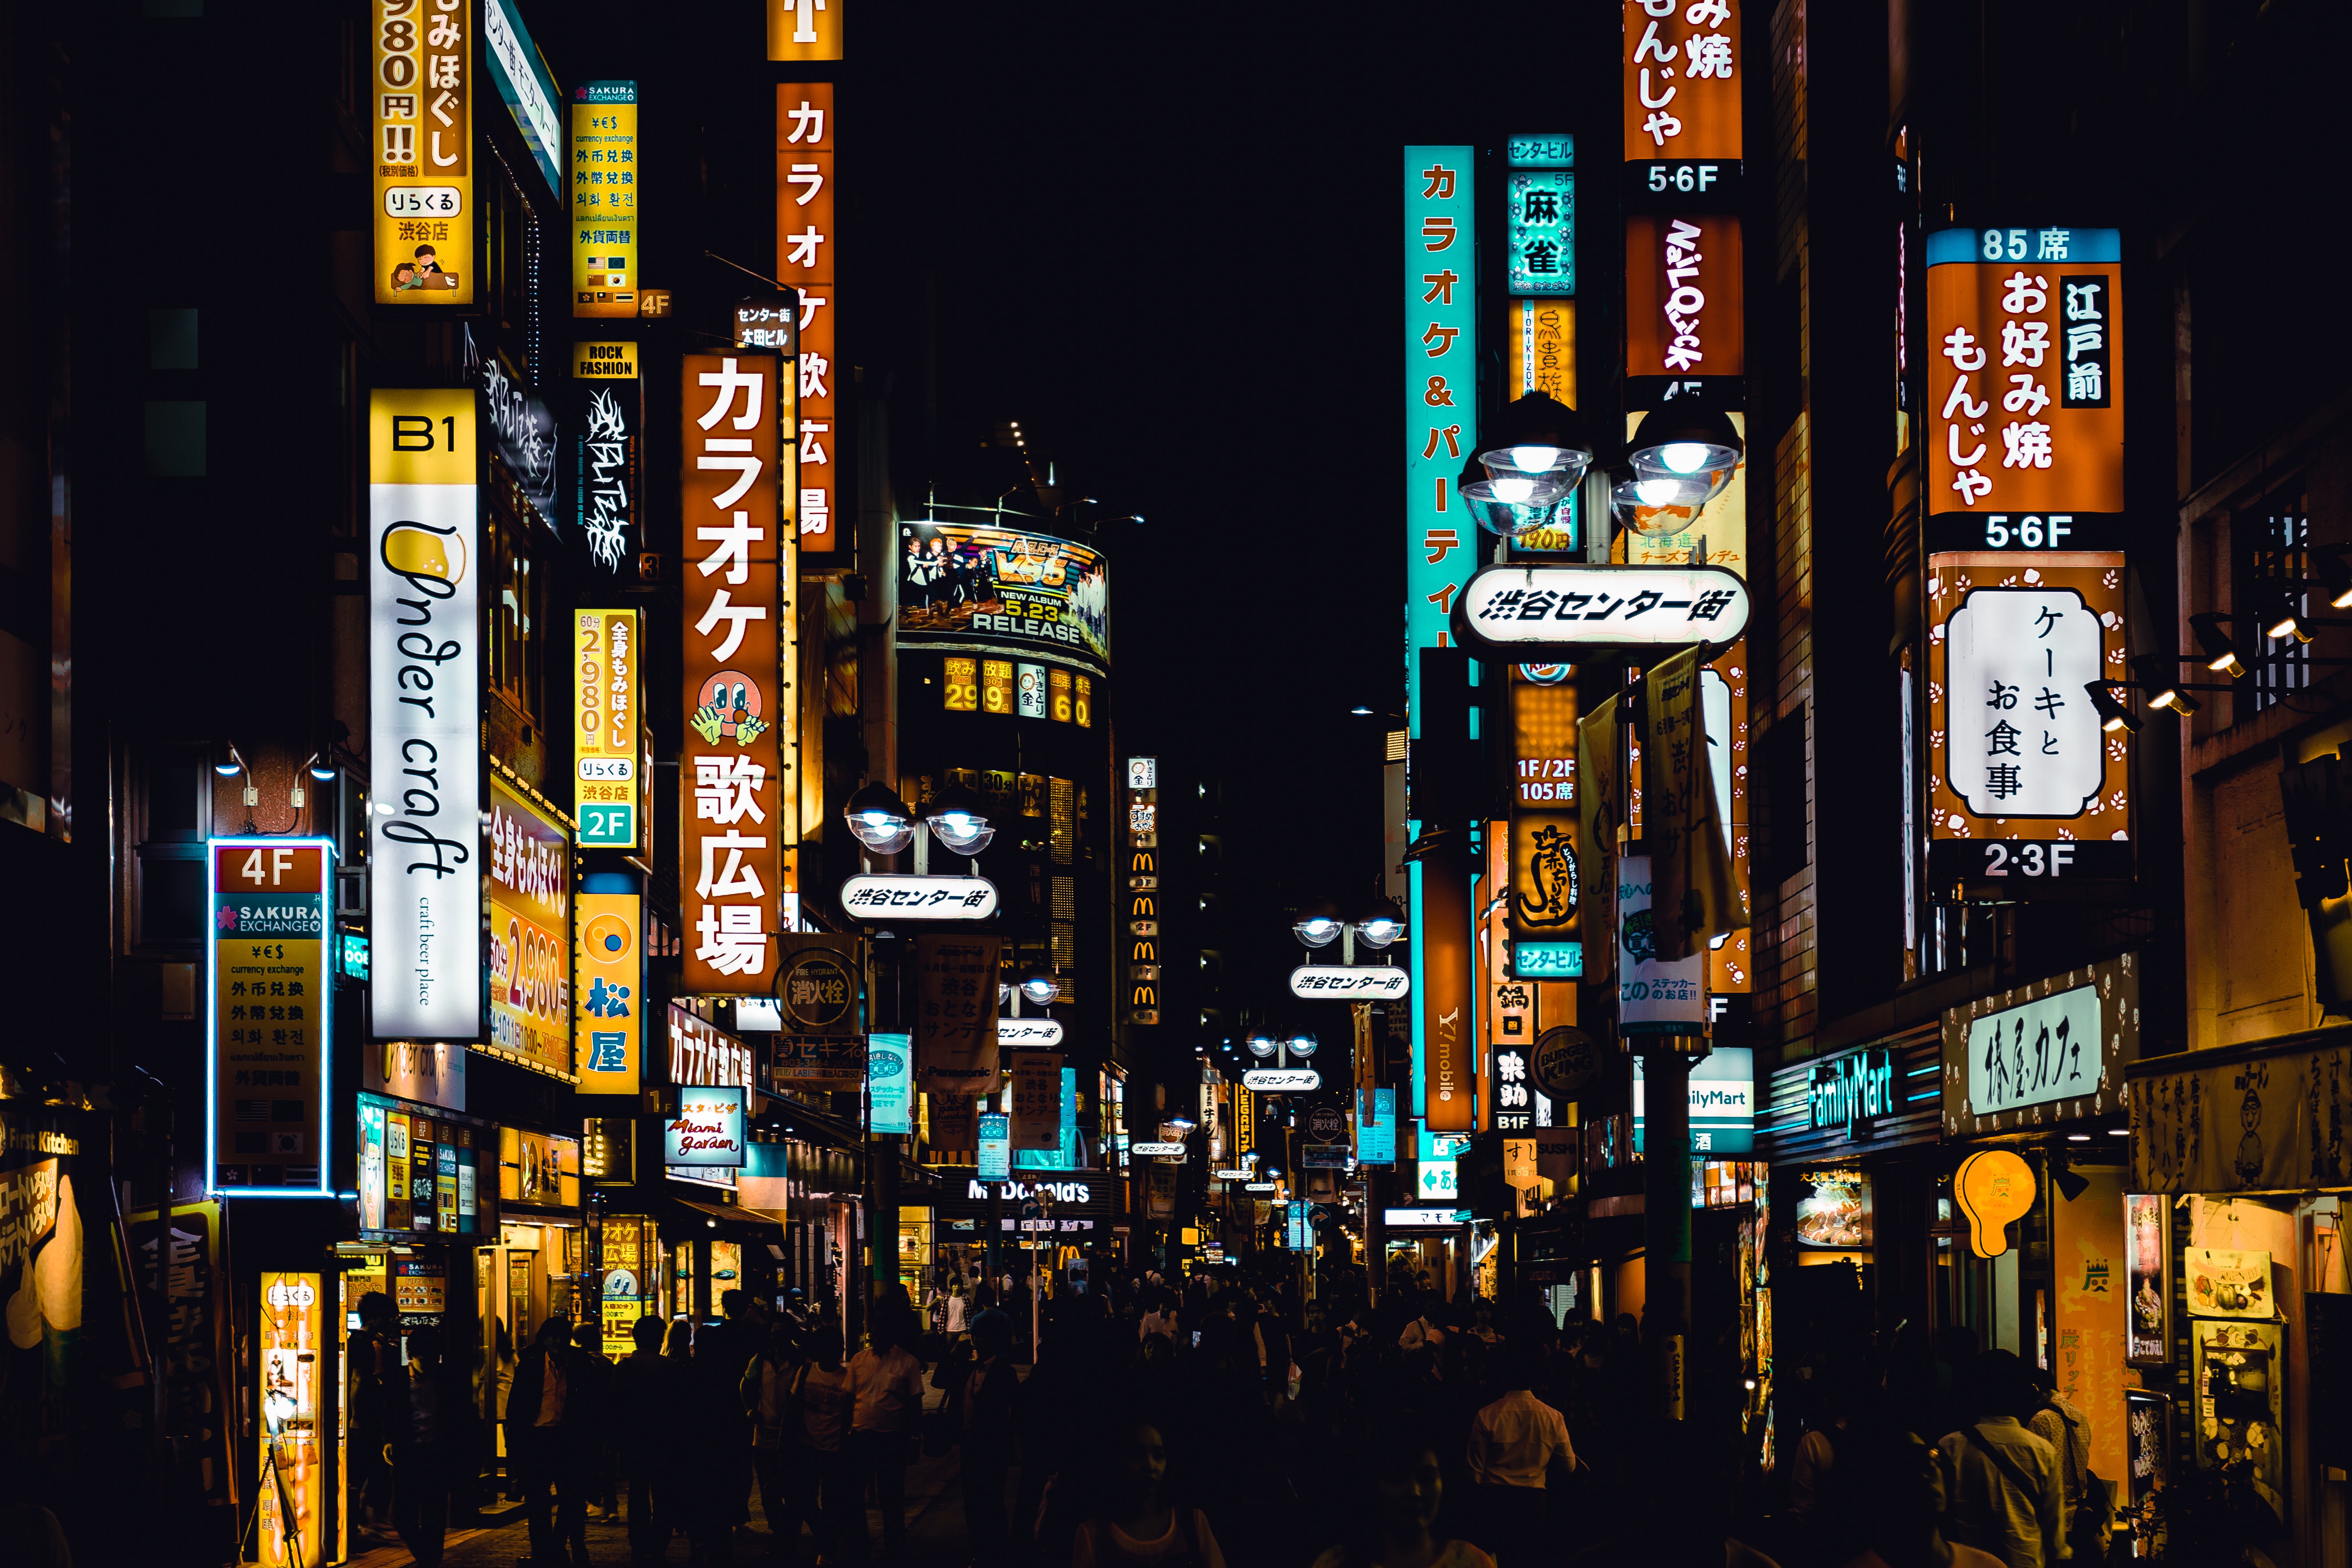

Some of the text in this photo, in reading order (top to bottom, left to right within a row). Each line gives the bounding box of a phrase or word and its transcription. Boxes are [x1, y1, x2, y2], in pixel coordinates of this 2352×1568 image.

[1685, 0, 1733, 78] み焼
[576, 134, 634, 144] currency exchange
[576, 149, 634, 163] 外币兑换
[1510, 142, 1573, 159] センタービル
[1555, 174, 1573, 187] 5F
[392, 194, 453, 210] りらくる
[576, 192, 634, 207] 외화 환전
[398, 222, 448, 241] 渋谷店
[579, 230, 631, 244] 外貨両替
[1524, 190, 1559, 274] 麻雀
[641, 295, 668, 314] 4F
[738, 308, 791, 323] センター街
[2066, 284, 2102, 401] 江戸前
[589, 346, 624, 359] ROCK
[580, 362, 632, 375] FASHION
[2002, 271, 2053, 469] お好み焼
[1942, 327, 1993, 506] もんじゃ
[393, 416, 454, 452] B1
[1640, 533, 1693, 548] 北海道
[1640, 550, 1741, 564] チーズフンデュ
[1001, 591, 1062, 607] NEW ALBUM
[1478, 589, 1737, 621] 渋谷センター街
[1005, 600, 1058, 622] 5.23
[973, 613, 1080, 644] RELEASE
[695, 358, 767, 976] カラオケ 歌広場
[580, 615, 602, 746] 60分 2,980円
[611, 622, 628, 747] 全身もみほぐし
[2034, 605, 2066, 756] ケーキと
[1022, 691, 1034, 707] 金
[1035, 669, 1044, 715] やきとり
[1985, 680, 2023, 800] お食事
[584, 763, 628, 776] りらくる
[984, 772, 1013, 791] 30分
[1134, 775, 1144, 785] 金
[583, 785, 629, 800] 渋谷店
[1520, 782, 1574, 801] 105席
[381, 738, 469, 880] craft
[588, 812, 625, 837] 2F
[242, 849, 294, 885] 4F
[491, 805, 566, 918] 全身もみほぐし
[849, 889, 989, 907] 渋谷センター街
[240, 907, 321, 932] SAKURA EXCHANGE
[415, 897, 435, 1005] craft beer place
[1516, 949, 1581, 969] センタービル
[231, 965, 304, 976] currency exchange
[509, 917, 569, 1026] 2,980円
[231, 981, 304, 996] 外币兑换
[791, 979, 845, 1004] 消火栓
[941, 978, 978, 997] 渋谷
[1297, 976, 1405, 990] 渋谷センター街
[1621, 981, 1649, 1002] この
[1652, 979, 1696, 988] ステッカー
[1497, 985, 1530, 1010] 鍋
[1652, 989, 1697, 1000] のお店!!
[924, 1000, 993, 1017] おとなり
[584, 977, 631, 1072] 松屋
[924, 1022, 994, 1039] サンデー
[998, 1027, 1058, 1039] センター街
[231, 1029, 304, 1045] 외화 환전
[775, 1037, 863, 1059] 質 セキネ
[1439, 1006, 1458, 1102] Y! mobile
[1541, 1042, 1592, 1065] BURGER
[670, 1009, 752, 1111] カラオケ歌広場
[789, 1059, 854, 1068] 03-3464-2061
[1543, 1055, 1595, 1083] KING
[1984, 1015, 2082, 1107] 椿屋カフェ
[235, 1070, 300, 1086] 外貨両替
[775, 1068, 792, 1077] 買取
[928, 1066, 991, 1078] Panasonic
[1247, 1076, 1318, 1086] 渋谷センター街
[1025, 1079, 1048, 1091] 渋谷
[1015, 1092, 1058, 1104] おとなり
[1808, 1050, 1893, 1140] FamilyMart
[1015, 1105, 1058, 1115] サンデー
[667, 1119, 724, 1134] Miami
[1203, 1108, 1216, 1138] 牛タン
[1312, 1118, 1339, 1131] 消火栓
[1498, 1115, 1530, 1129] B1F
[9, 1127, 79, 1155] First Kitchen
[1537, 1143, 1578, 1155] SUSHI
[1695, 1132, 1712, 1151] 酒
[1506, 1141, 1537, 1162] すし
[2060, 1329, 2080, 1400] 炭リッチ
